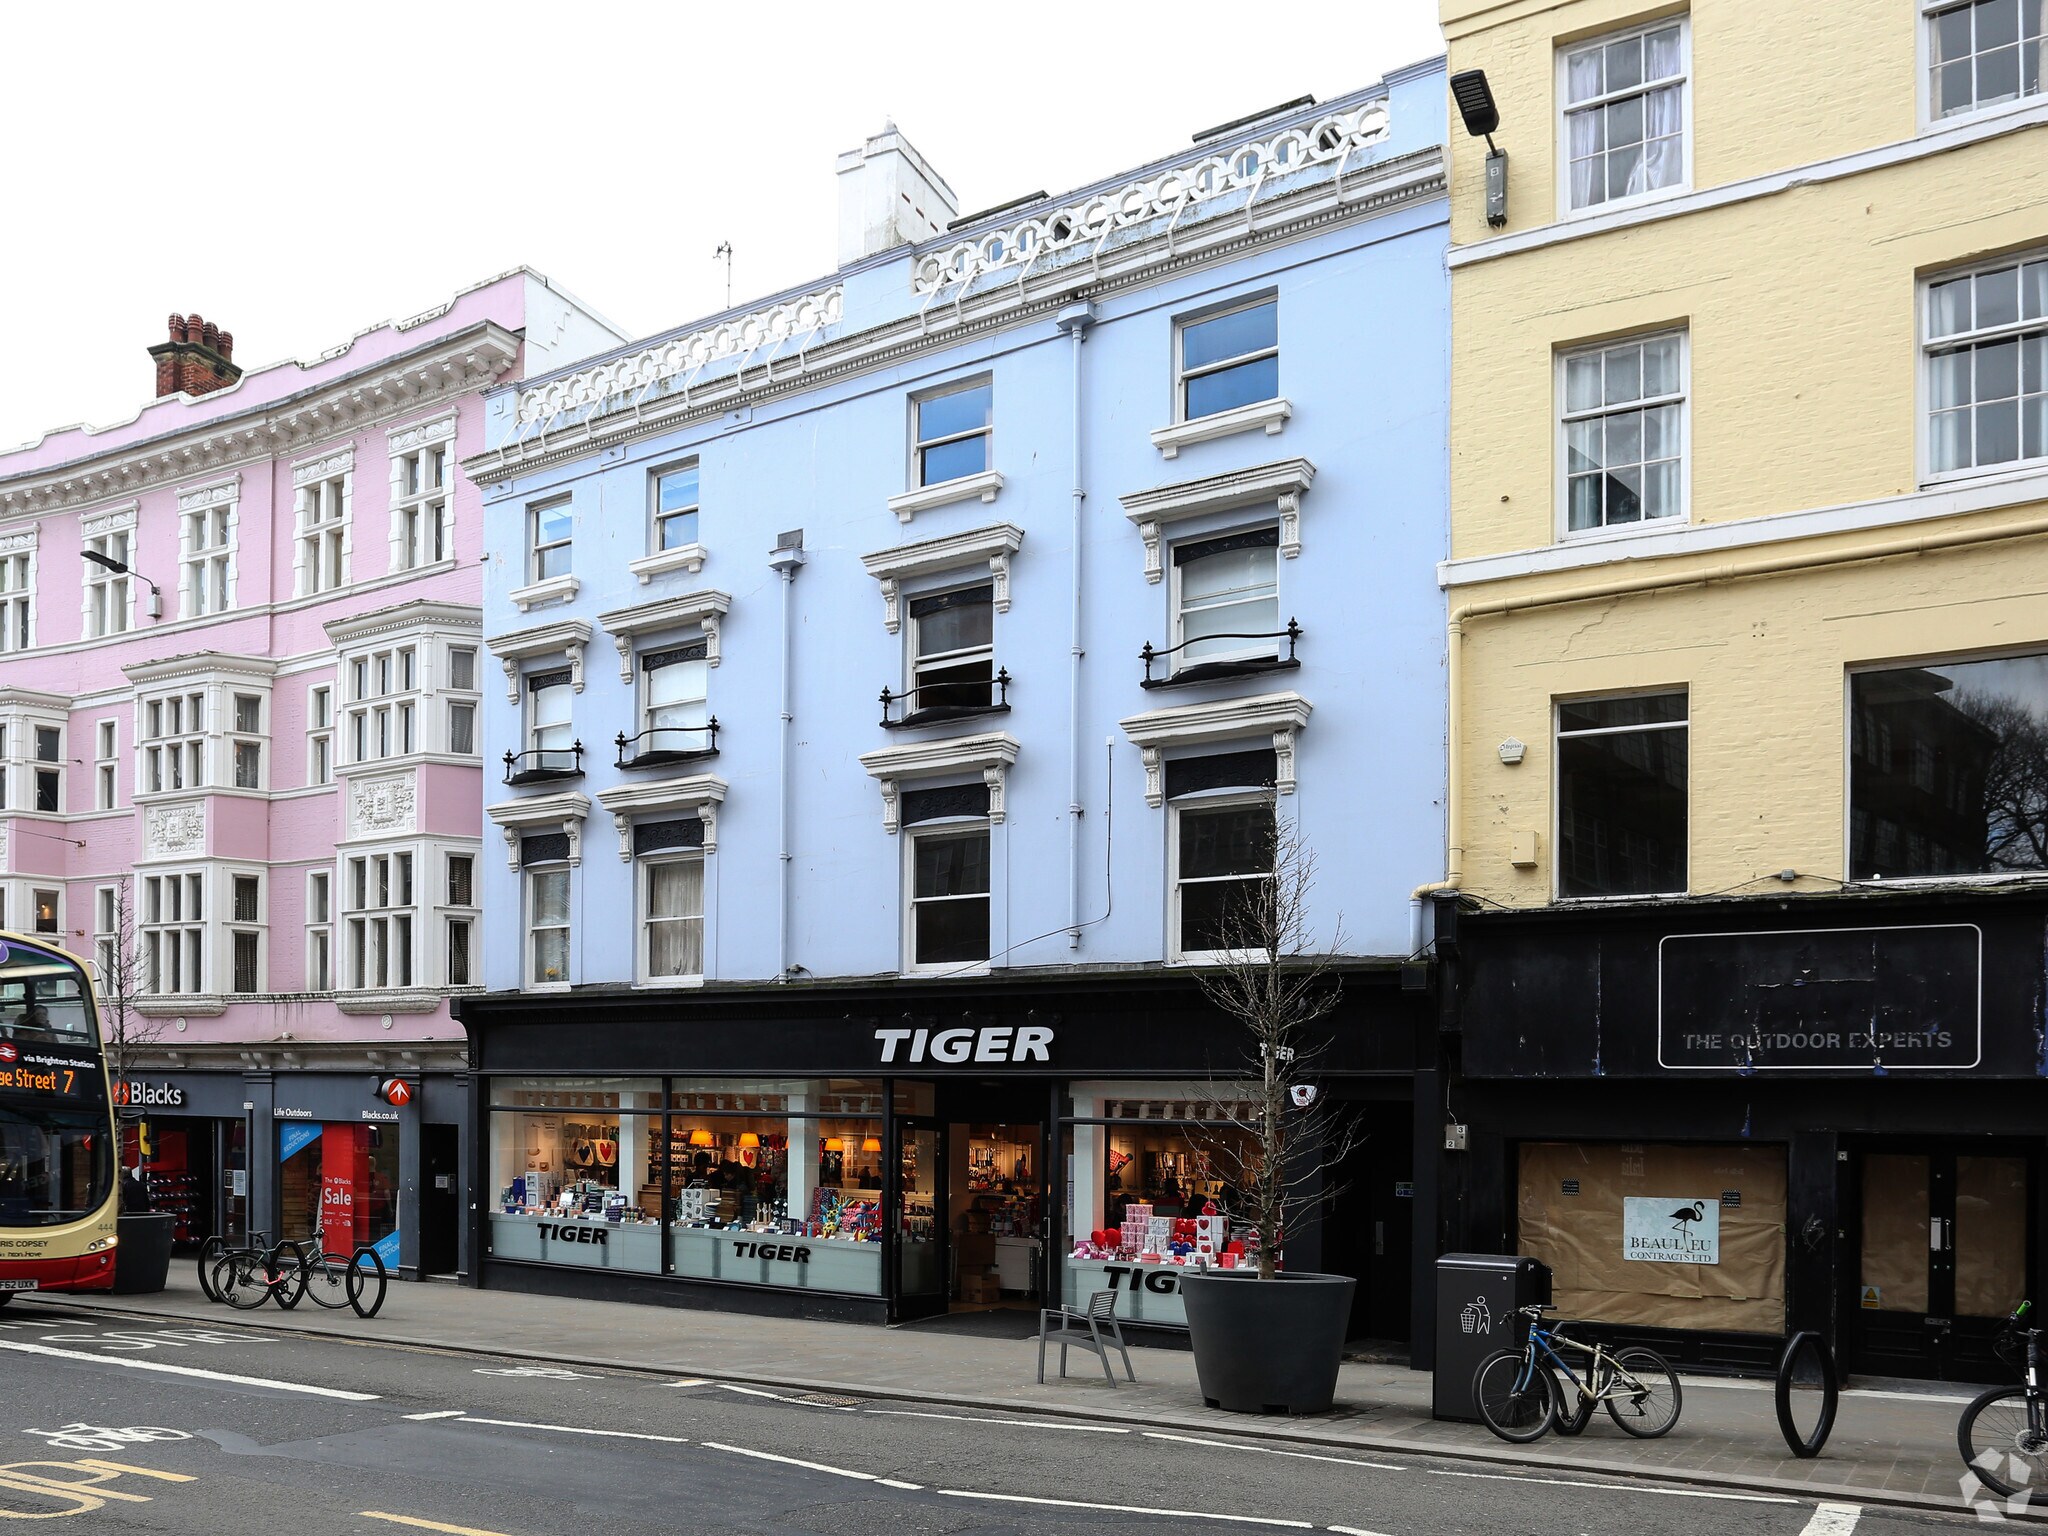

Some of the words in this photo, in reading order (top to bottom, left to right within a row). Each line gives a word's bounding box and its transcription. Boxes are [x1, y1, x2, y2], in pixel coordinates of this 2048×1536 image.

[875, 1027, 1054, 1063] TIGER
[1683, 1034, 1722, 1050] THE
[1730, 1032, 1840, 1049] OUTDOOR
[1849, 1031, 1952, 1048] EXPERTS
[23, 1054, 35, 1063] via
[36, 1056, 68, 1066] Brighton
[69, 1059, 96, 1069] Station
[0, 1071, 13, 1087] ge
[15, 1068, 57, 1090] Street
[63, 1069, 74, 1094] 7
[130, 1081, 182, 1105] Blacks
[273, 1107, 285, 1117] Life
[285, 1108, 312, 1118] Outdoors
[361, 1110, 399, 1120] Blacks.co.uk
[283, 1130, 310, 1152] REDUCTIONS
[288, 1129, 302, 1142] FINAL
[324, 1187, 352, 1206] Sale
[97, 1223, 113, 1232] 444
[536, 1222, 608, 1245] TIGER
[0, 1240, 14, 1248] RIS
[16, 1240, 48, 1248] COPSEY
[379, 1240, 393, 1253] FINAL
[733, 1241, 811, 1263] TIGER
[1630, 1251, 1690, 1261] CONTRACTS
[1692, 1253, 1711, 1262] LTD
[0, 1280, 16, 1289] F62
[18, 1280, 35, 1289] UXK
[1102, 1265, 1182, 1295] TIG
